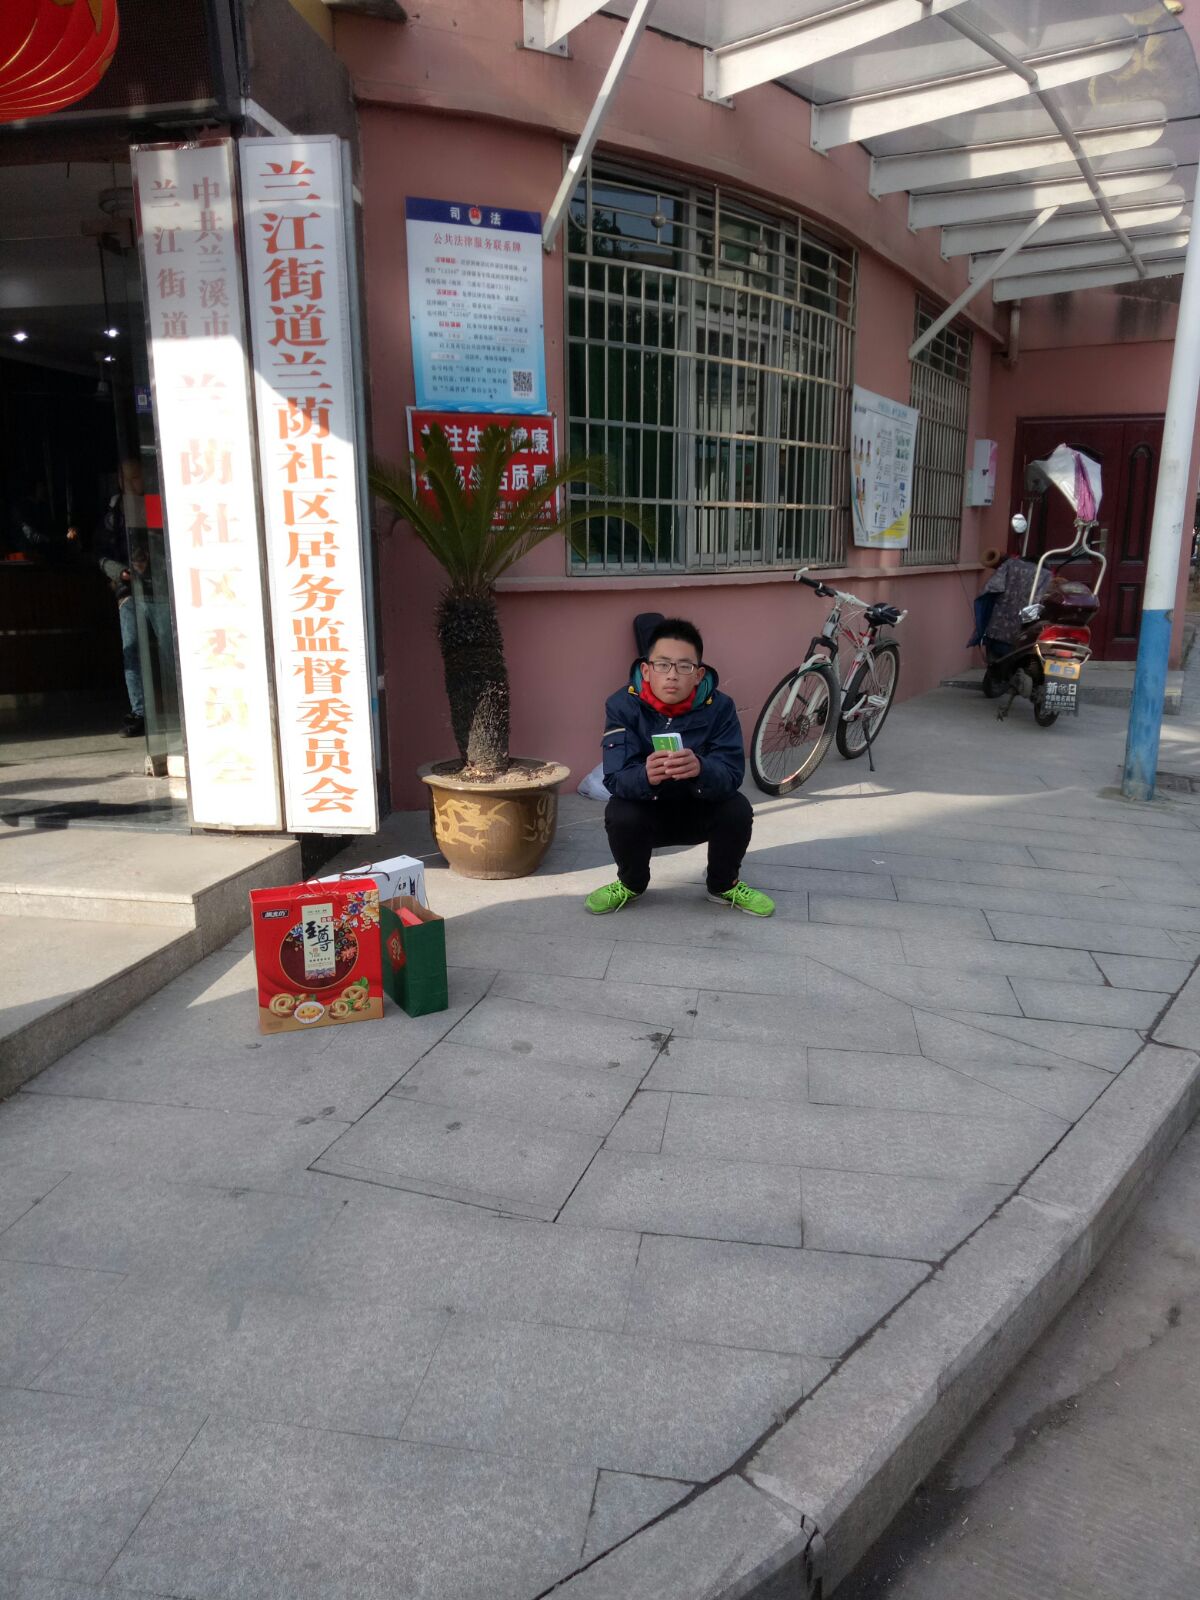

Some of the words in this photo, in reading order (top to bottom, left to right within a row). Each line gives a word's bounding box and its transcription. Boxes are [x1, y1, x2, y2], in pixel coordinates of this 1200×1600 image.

[150, 179, 190, 341] 兰江街道
[192, 176, 231, 341] 中共兰溪市
[258, 160, 359, 814] 兰江街道兰荫社区居务监督委员会
[305, 920, 334, 951] 至尊
